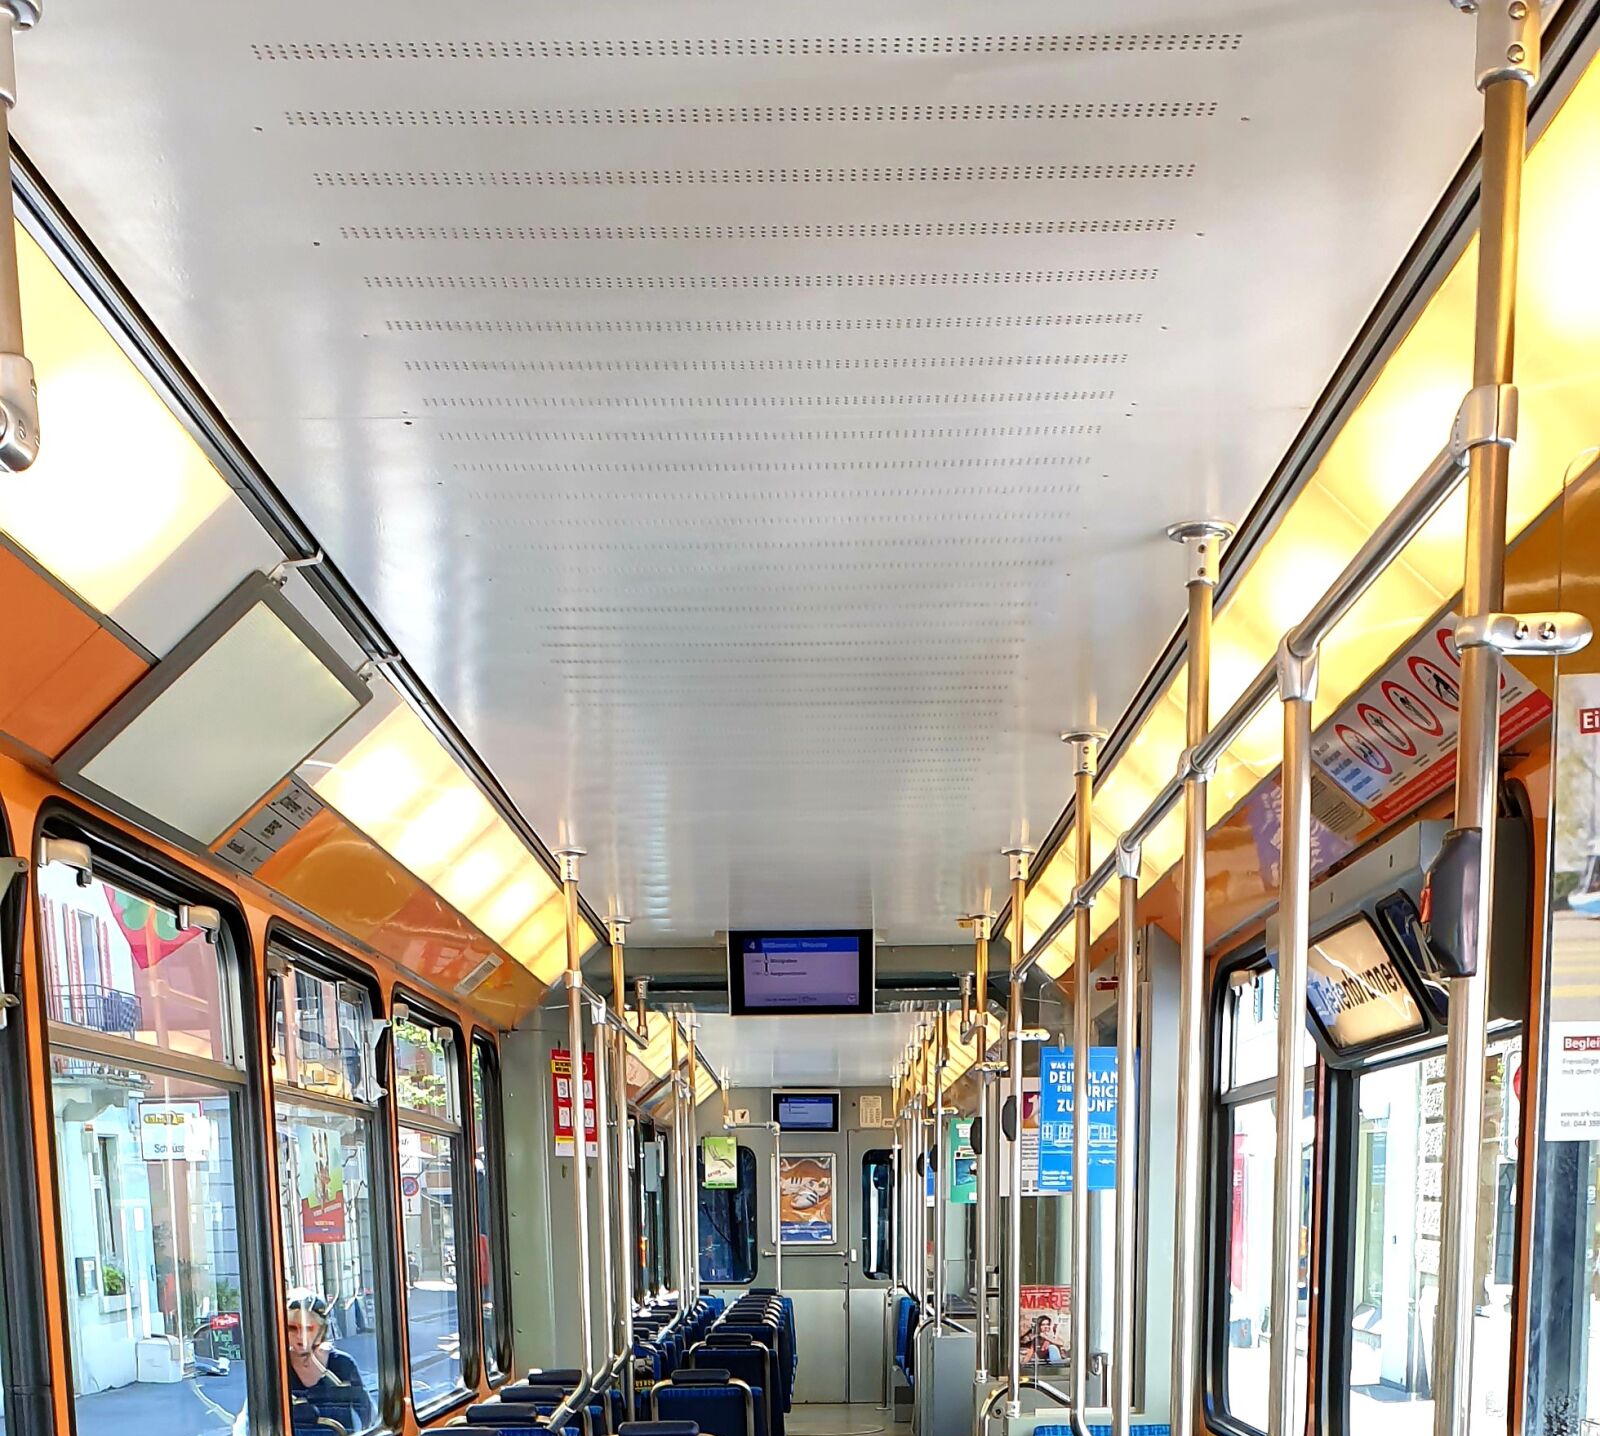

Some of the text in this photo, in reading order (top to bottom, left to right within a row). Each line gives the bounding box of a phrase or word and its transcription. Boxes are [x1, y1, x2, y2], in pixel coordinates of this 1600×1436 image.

[1308, 961, 1402, 1016] Tiefenbrunne
[1050, 1062, 1066, 1070] WAS
[1057, 1099, 1118, 1113] ZUUNF
